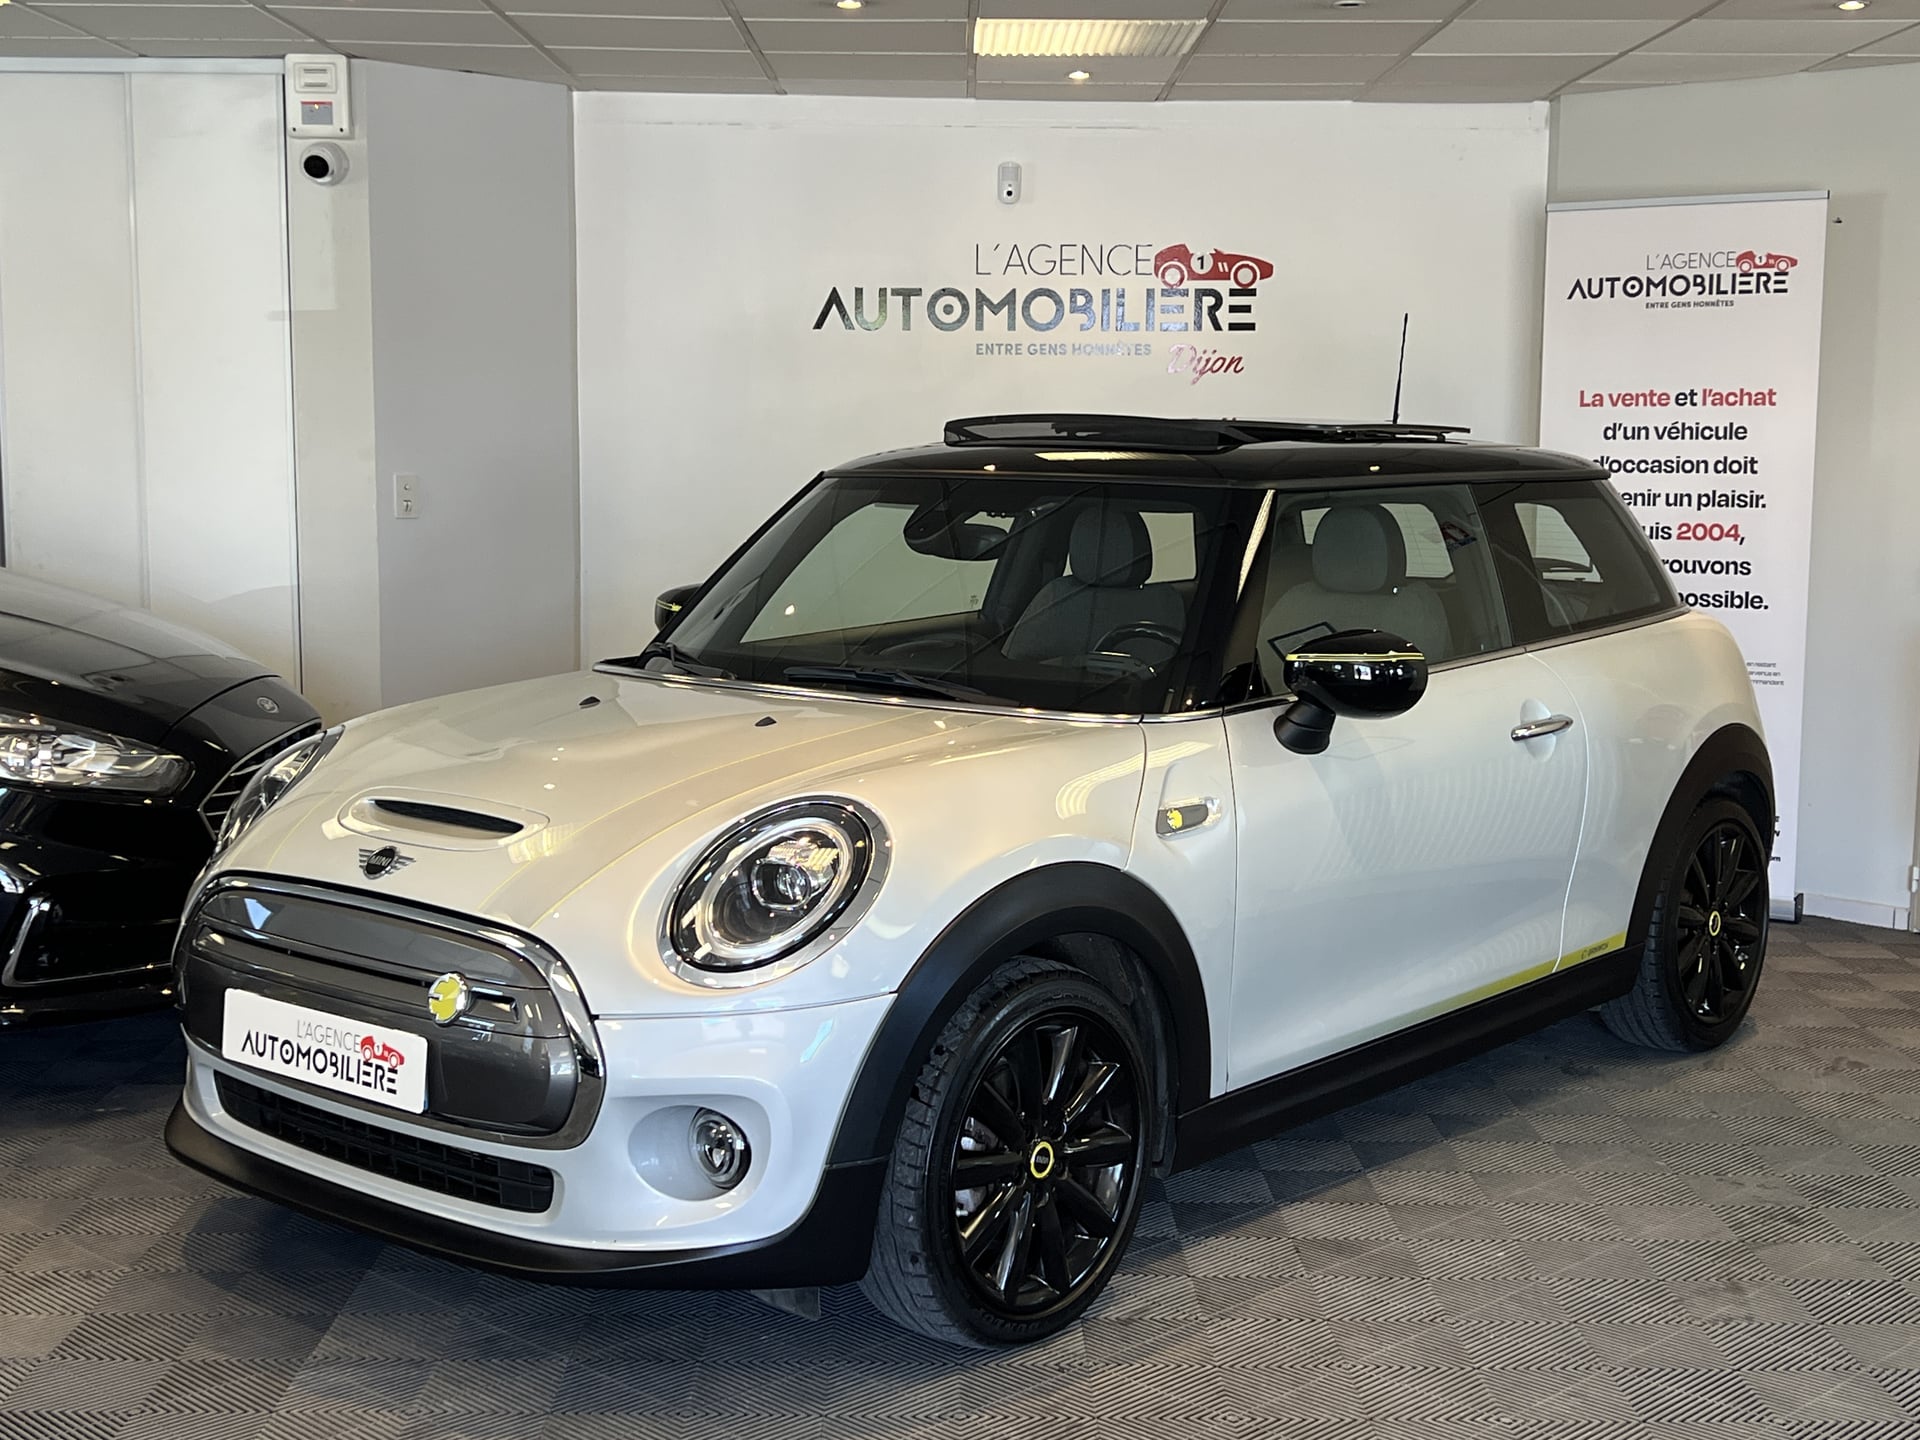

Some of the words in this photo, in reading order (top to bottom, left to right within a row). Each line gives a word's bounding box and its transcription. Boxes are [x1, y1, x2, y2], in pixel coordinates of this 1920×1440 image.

[975, 243, 1153, 276] L'AGENCE
[1196, 255, 1205, 270] 1
[1646, 250, 1737, 271] L'AGENCE
[1645, 301, 1669, 309] ENTRE
[1671, 300, 1692, 309] GENS
[975, 343, 1023, 356] ENTRE
[1027, 343, 1067, 356] GENS
[1167, 343, 1245, 386] Dijon
[1579, 390, 1604, 407] La
[1608, 391, 1671, 407] vente
[1674, 389, 1698, 407] et
[1701, 388, 1777, 407] l'achat
[1602, 422, 1650, 441] d'un
[1654, 421, 1748, 441] véhicule
[1713, 455, 1759, 475] doit
[1619, 488, 1662, 507] enir
[1664, 491, 1693, 507] un
[1696, 489, 1767, 511] plaisir.
[1676, 522, 1746, 545] 2004,
[1662, 558, 1752, 576] rouvons
[296, 1019, 361, 1054] L'AGENCE
